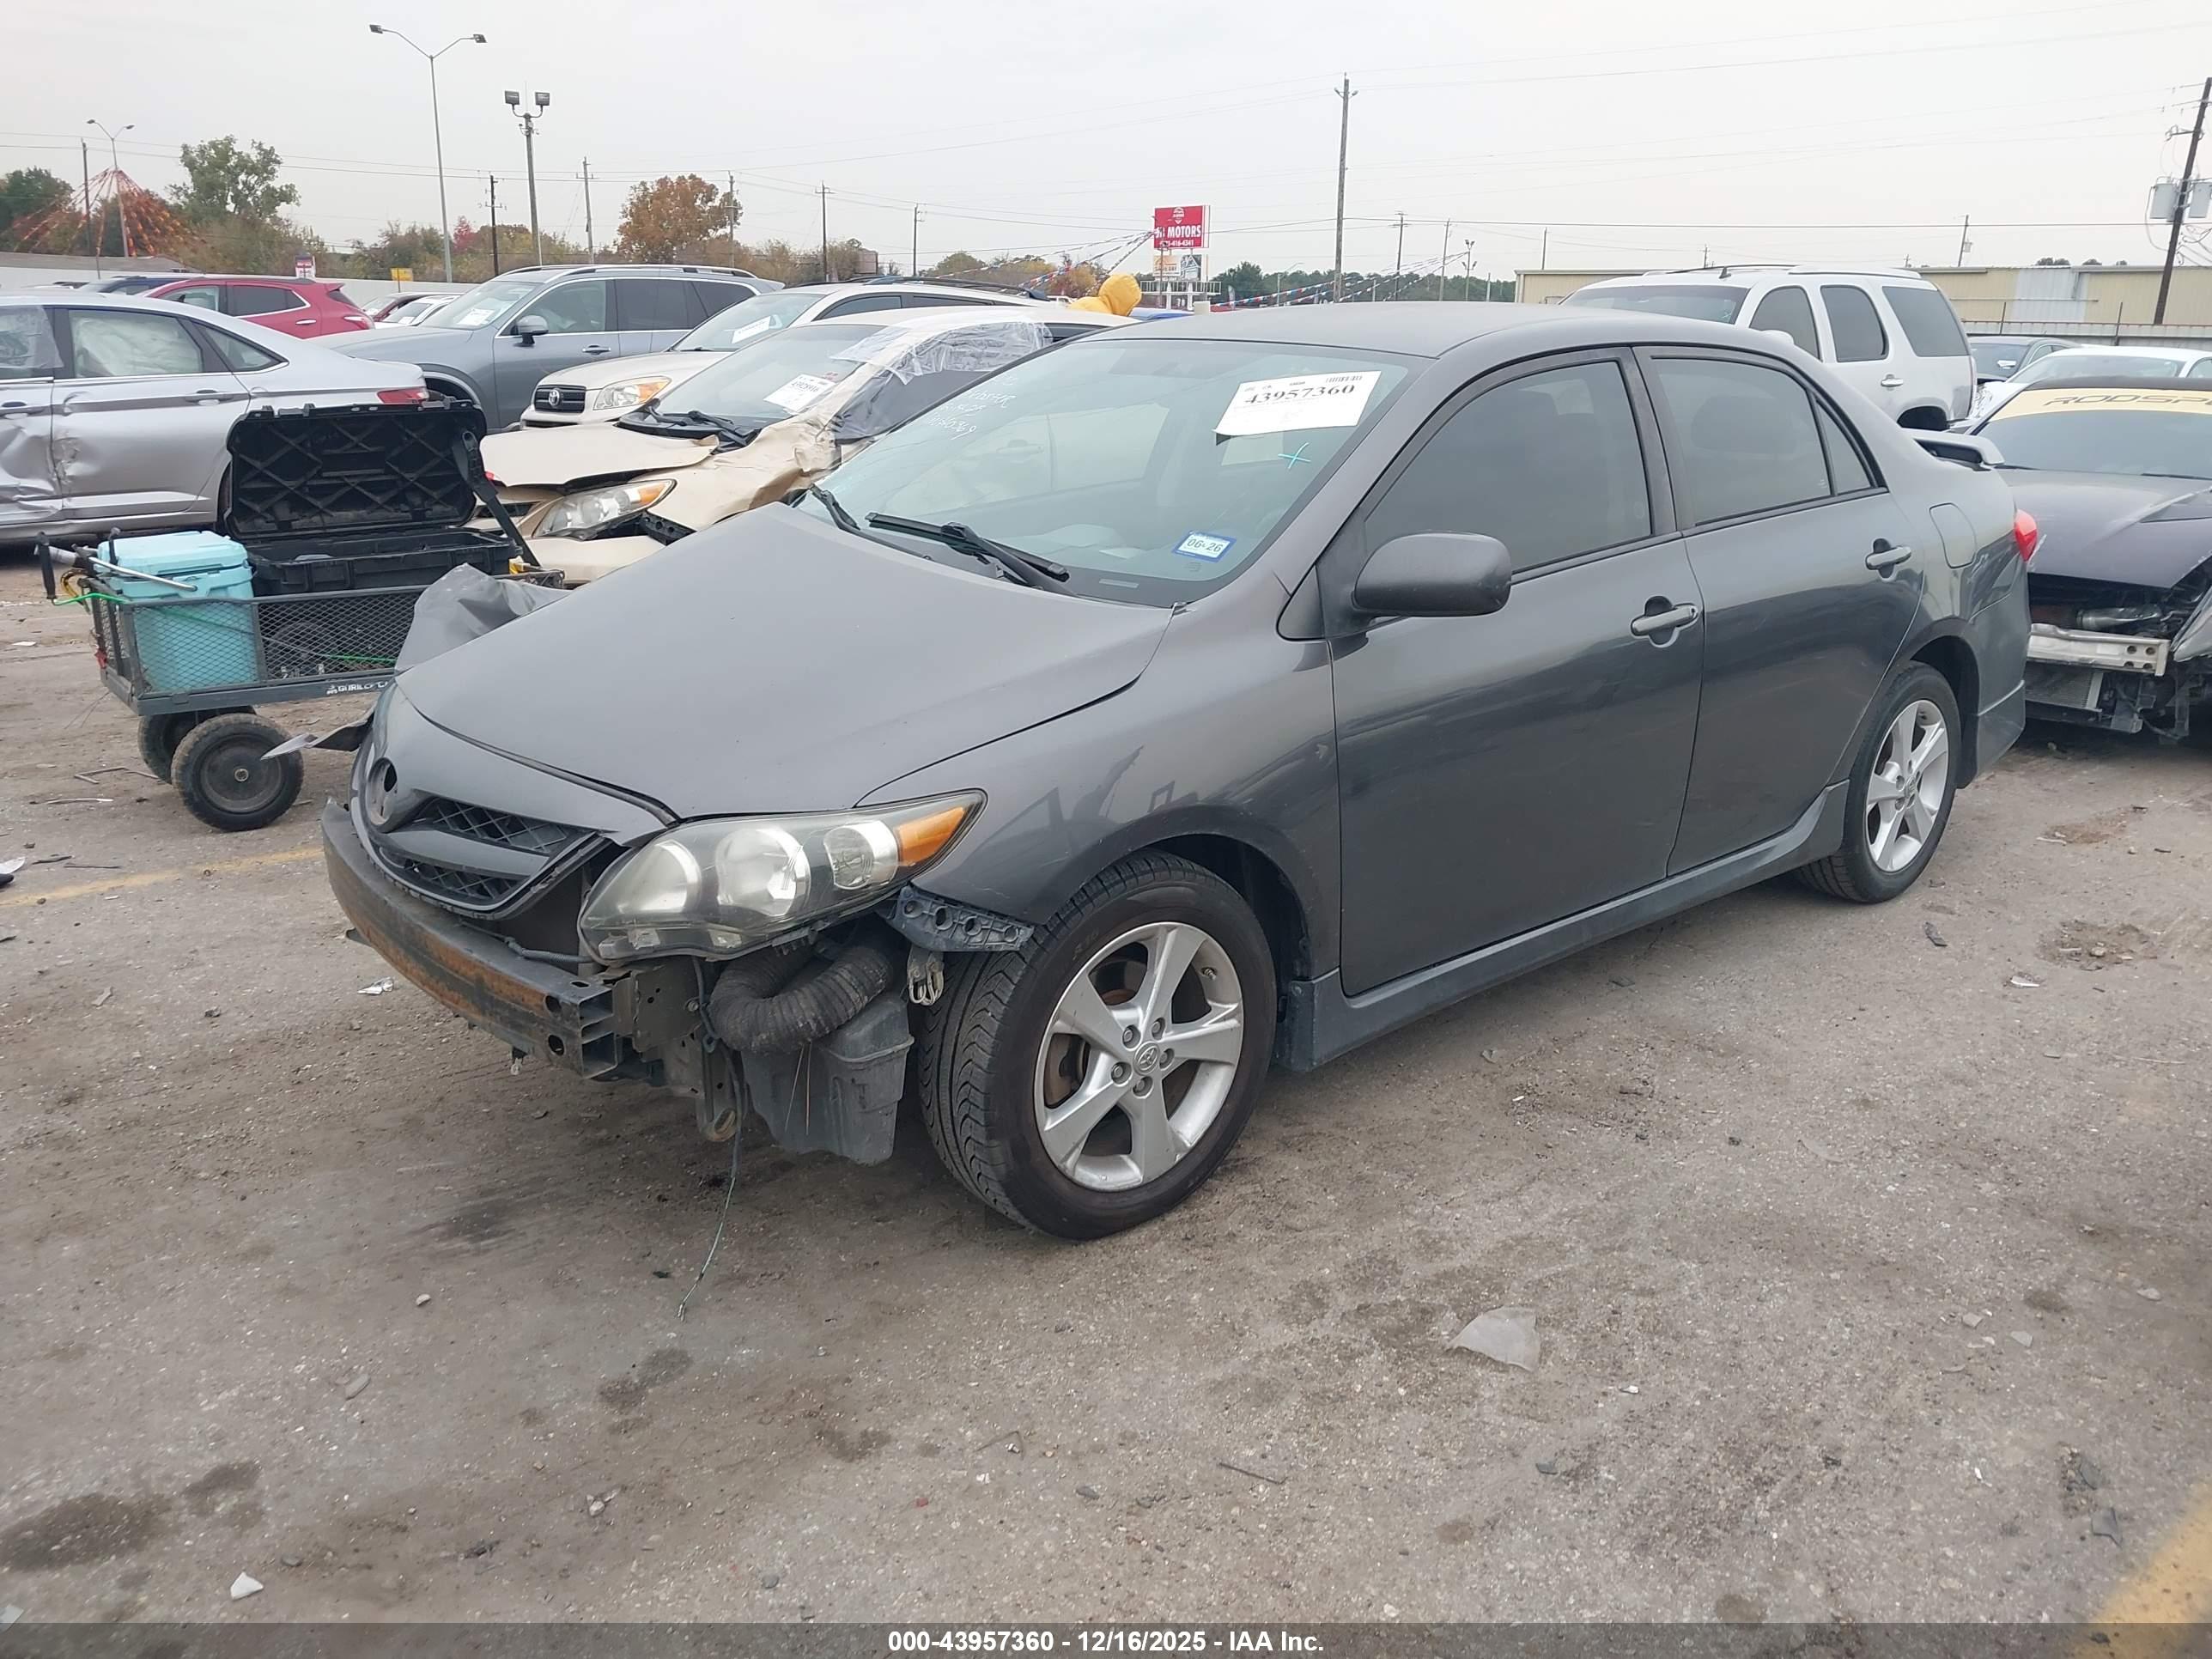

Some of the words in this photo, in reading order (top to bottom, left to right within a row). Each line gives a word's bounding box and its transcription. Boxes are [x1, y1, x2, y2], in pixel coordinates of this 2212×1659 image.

[1167, 225, 1201, 239] MOTORS
[1244, 384, 1356, 404] 43957360
[2043, 394, 2212, 406] RODSP
